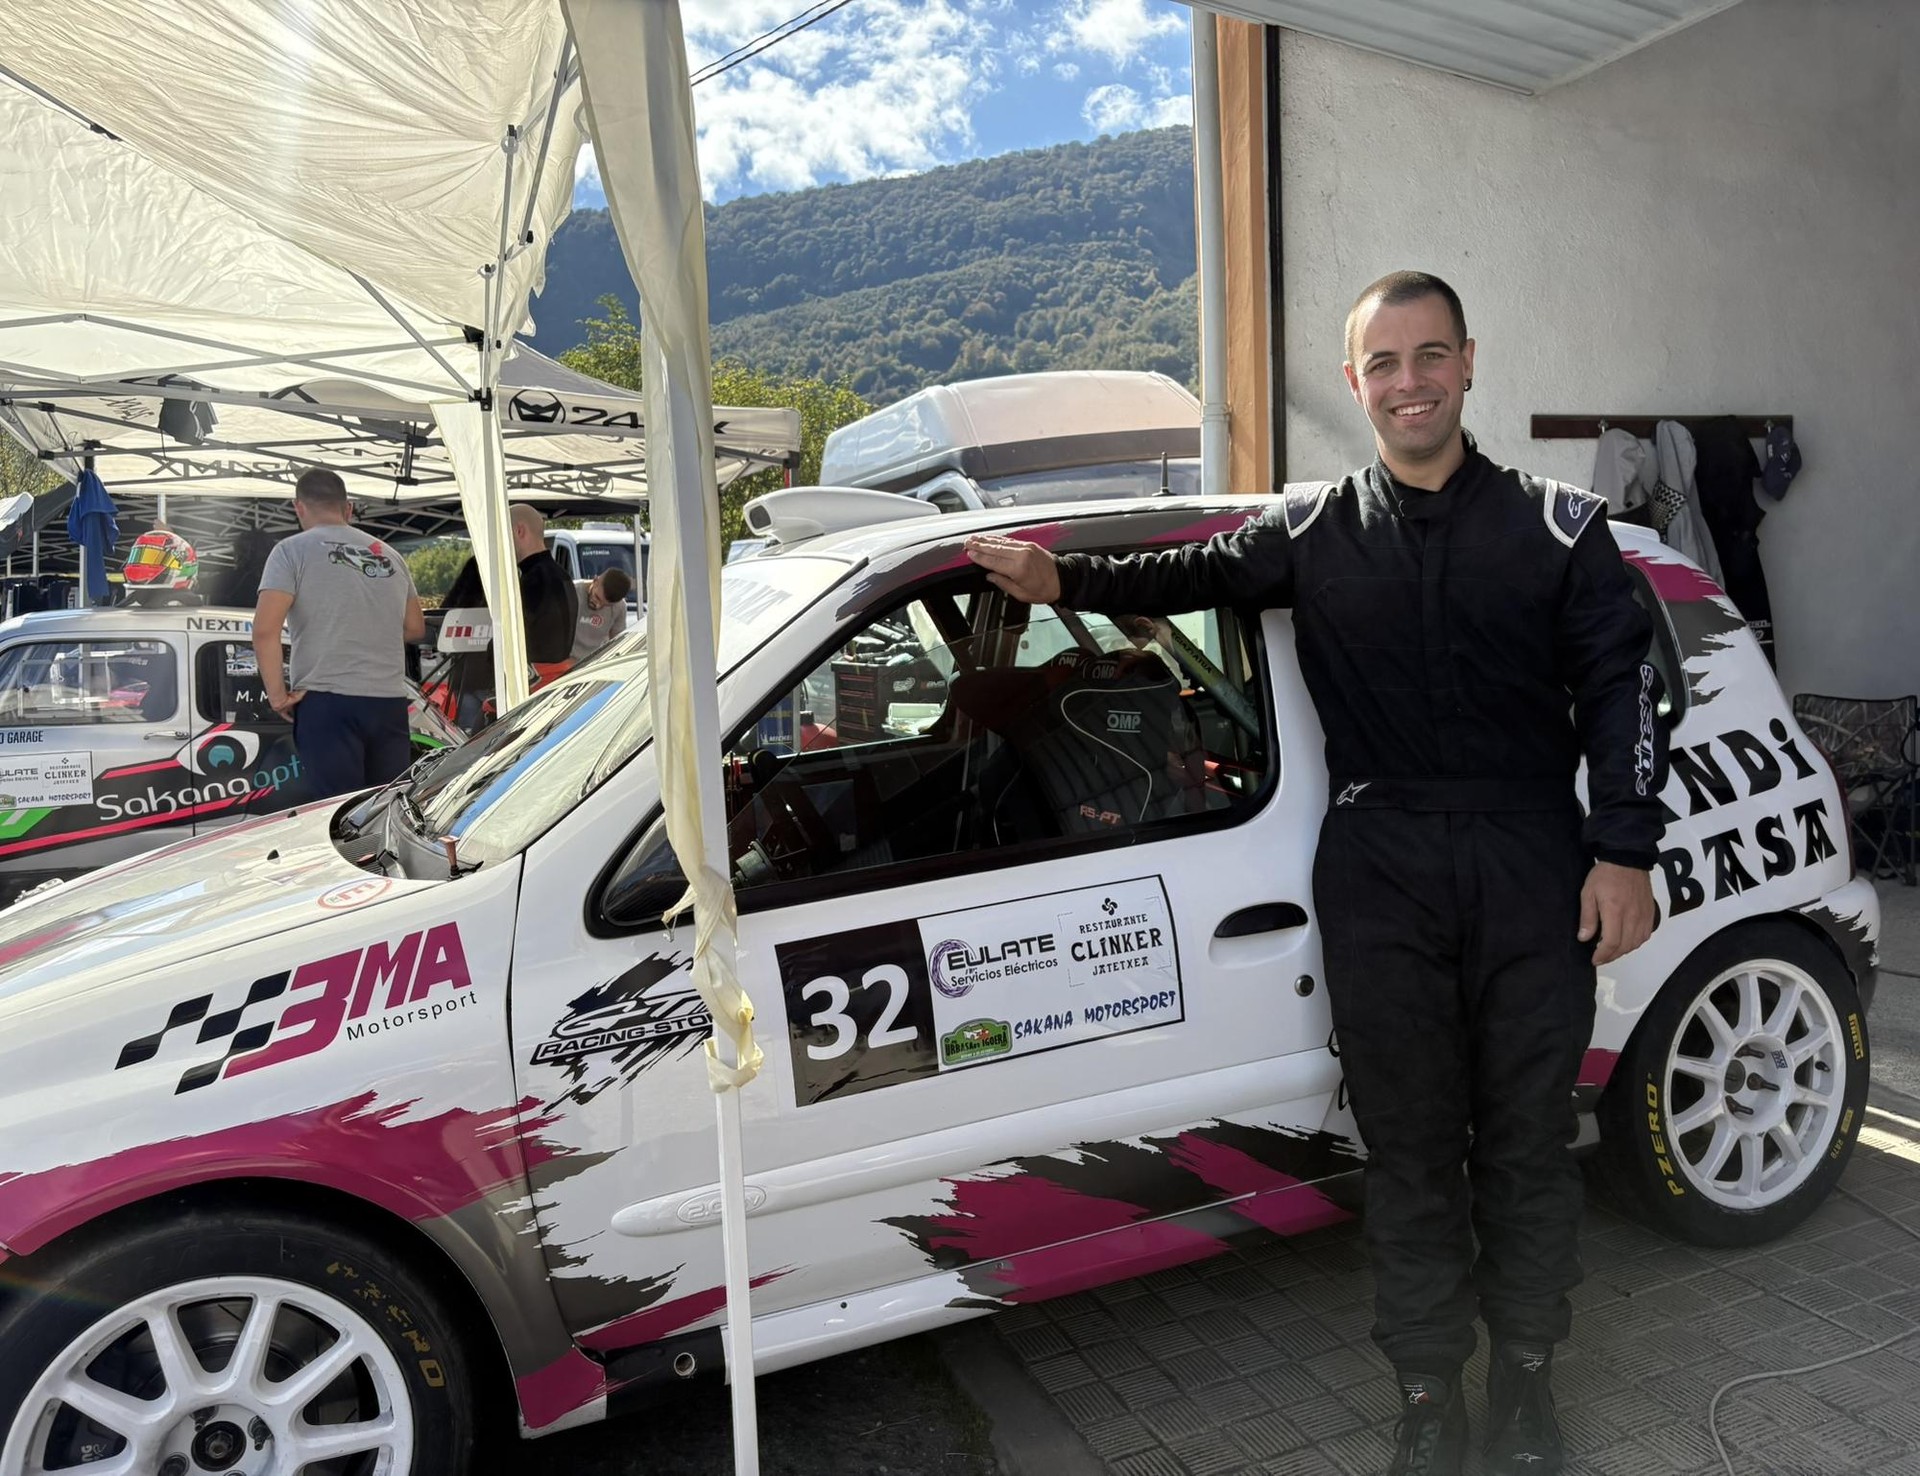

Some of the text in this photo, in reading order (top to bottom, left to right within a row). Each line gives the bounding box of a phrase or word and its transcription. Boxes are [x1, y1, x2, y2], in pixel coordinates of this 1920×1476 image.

[1107, 713, 1142, 731] OMP
[7, 730, 44, 745] GARAGE
[44, 769, 87, 780] CLINKER
[1079, 913, 1149, 934] RESTAURANTE
[946, 933, 1056, 971] EULATE
[950, 958, 1059, 987] Servicios Eléctricos
[1092, 956, 1149, 976] JATETXEA
[346, 991, 477, 1041] Motorsport
[802, 963, 918, 1060] 32
[1014, 990, 1176, 1039] SAKANA MOTORSPORT
